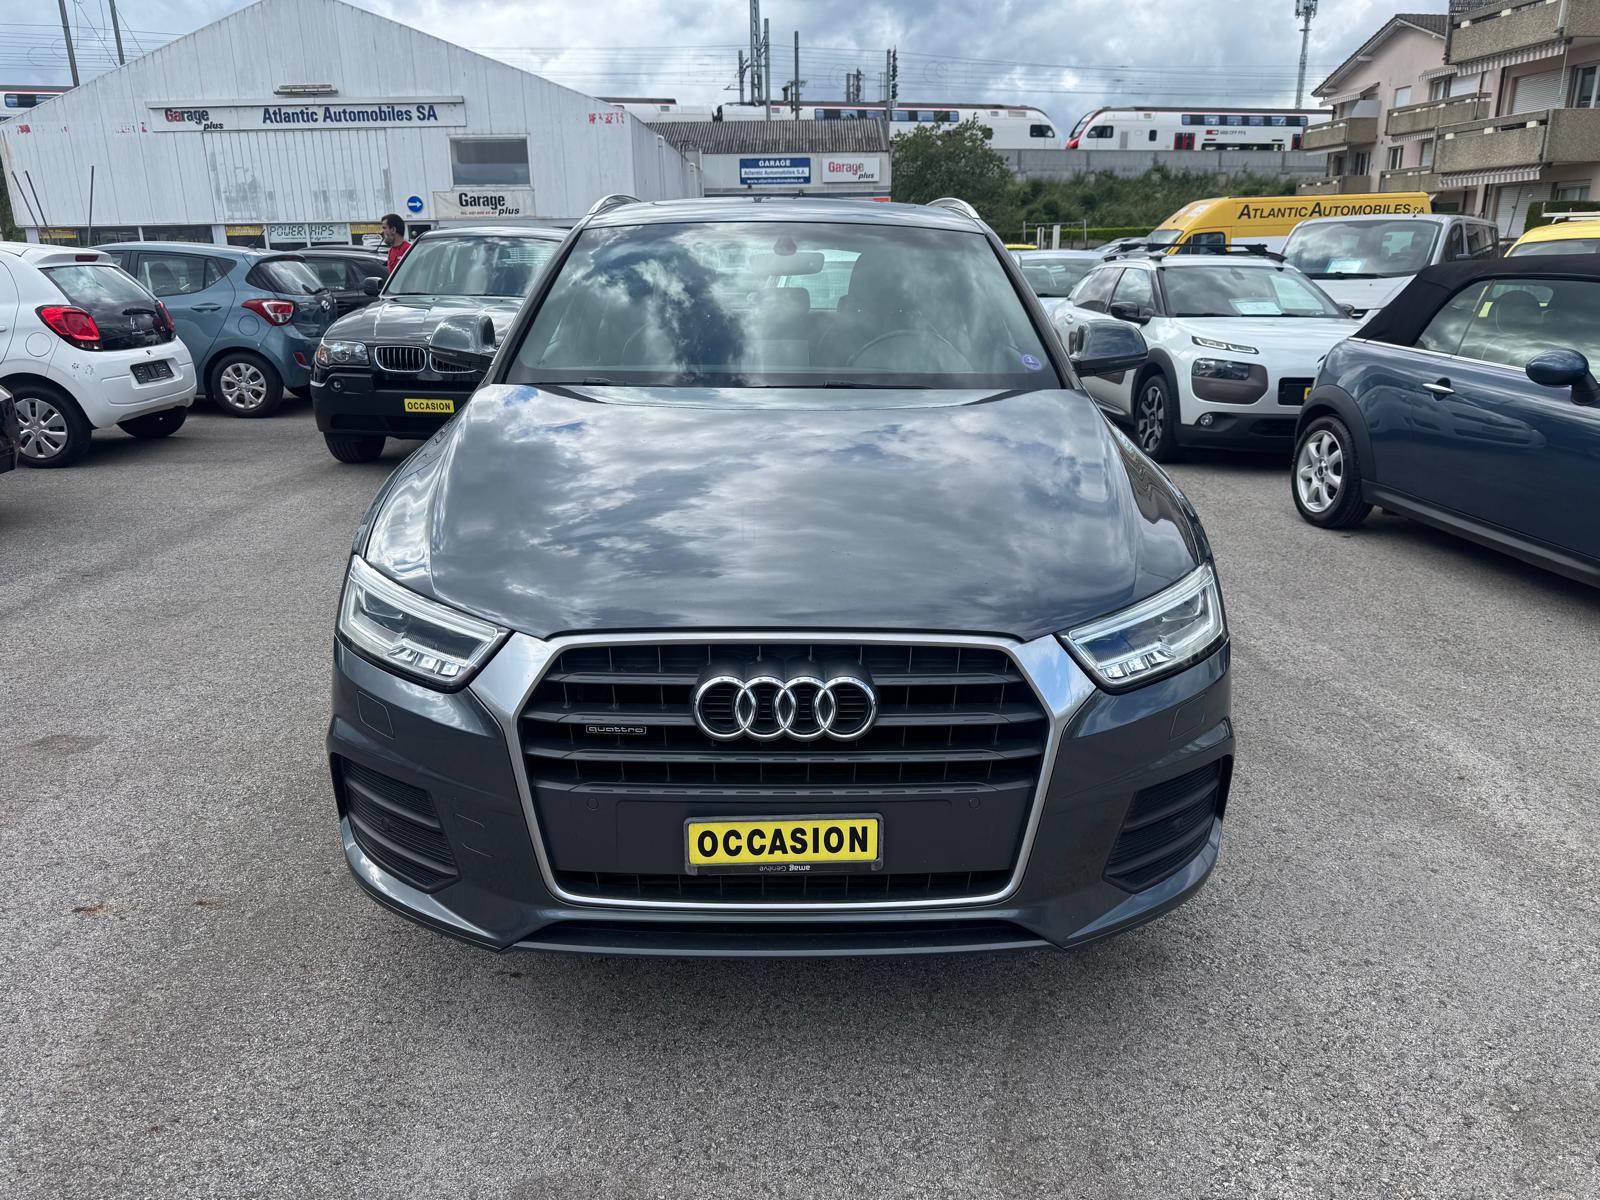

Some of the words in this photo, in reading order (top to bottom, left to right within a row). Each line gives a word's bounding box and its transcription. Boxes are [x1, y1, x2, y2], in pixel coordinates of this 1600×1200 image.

[165, 107, 210, 125] Garage
[262, 107, 318, 123] Atlantic
[322, 105, 412, 123] Automobiles
[416, 104, 438, 121] SA
[203, 121, 224, 131] plus
[828, 161, 864, 175] Garage
[858, 172, 874, 180] plus
[459, 192, 505, 210] Garage
[498, 207, 520, 216] plus
[1238, 203, 1308, 219] ATLANTIC
[1308, 201, 1411, 217] AUTOMOBILES
[407, 401, 451, 411] OCCASION
[697, 826, 868, 858] OCCASION
[789, 864, 811, 872] amag
